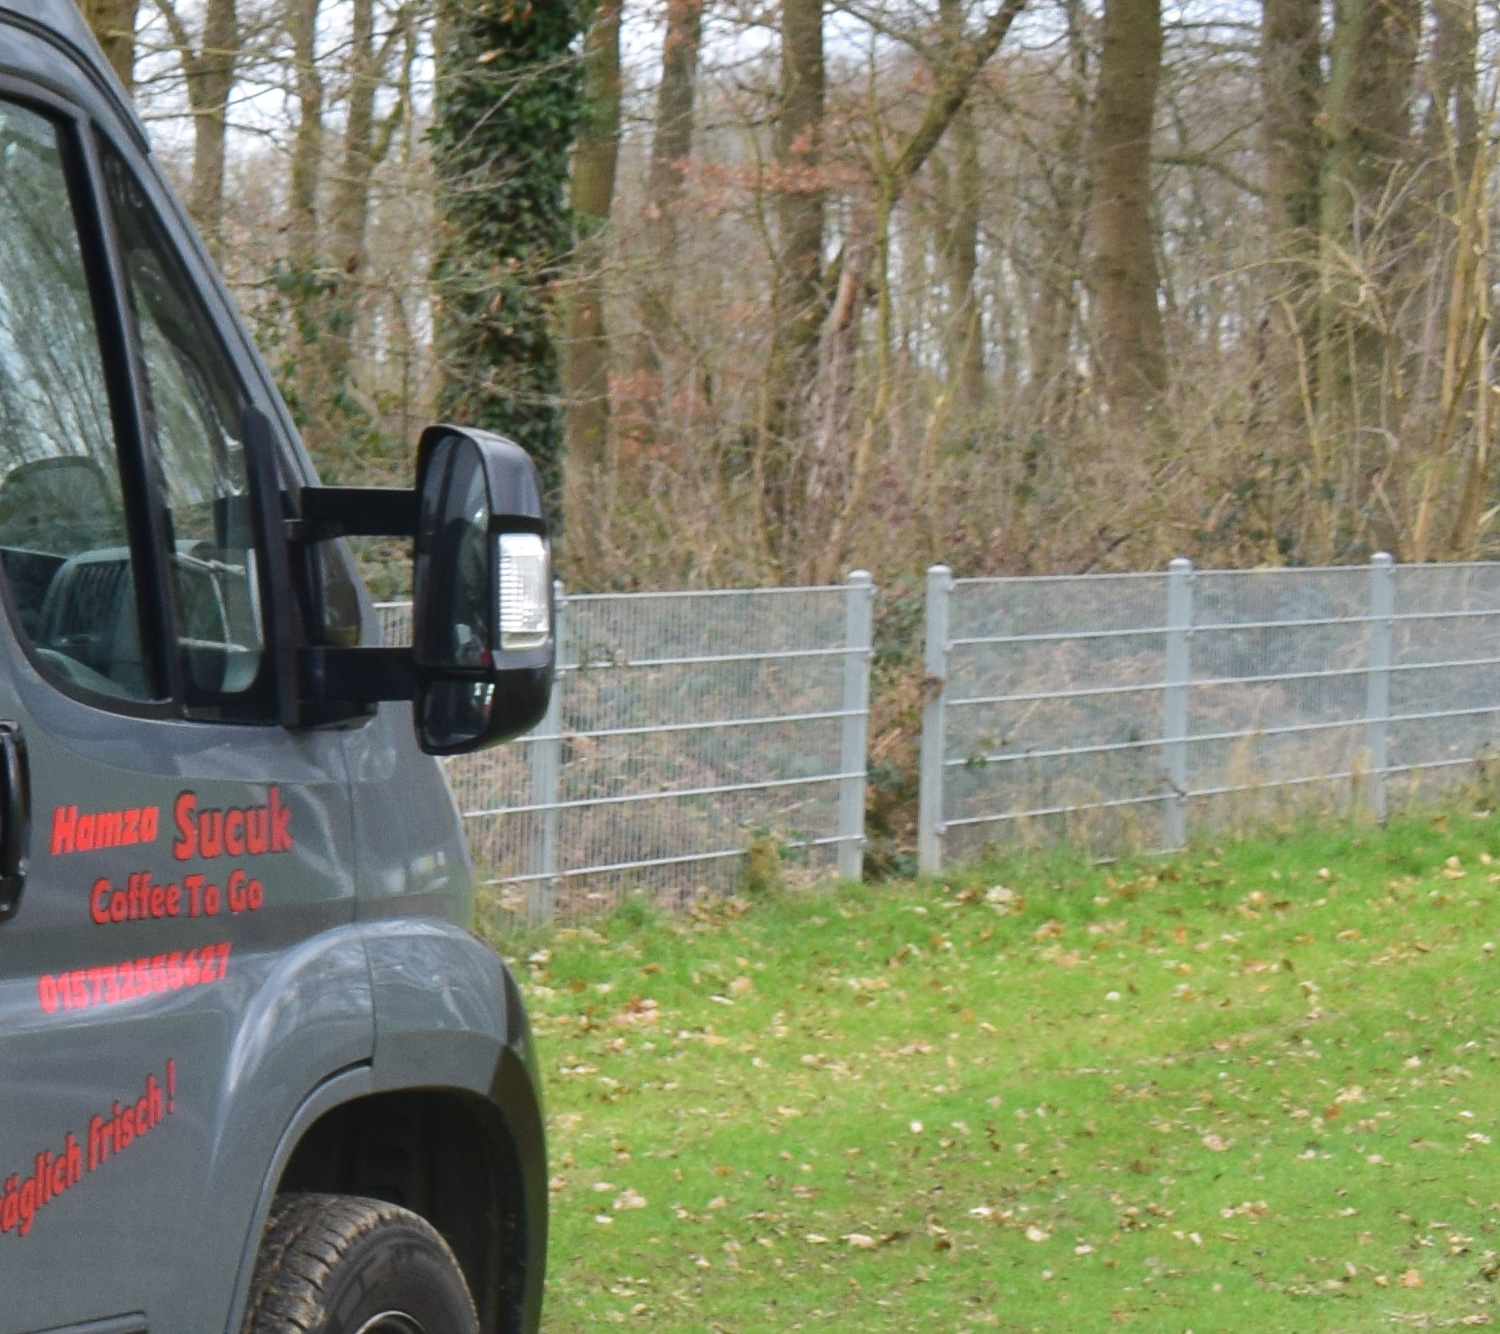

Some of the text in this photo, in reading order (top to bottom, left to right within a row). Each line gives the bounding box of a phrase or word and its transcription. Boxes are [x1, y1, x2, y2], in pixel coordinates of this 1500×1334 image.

[50, 784, 295, 861] Hamza Sucuk
[89, 868, 264, 925] Coffee To Go
[37, 942, 233, 1014] 015732555627
[87, 1073, 163, 1172] frisch
